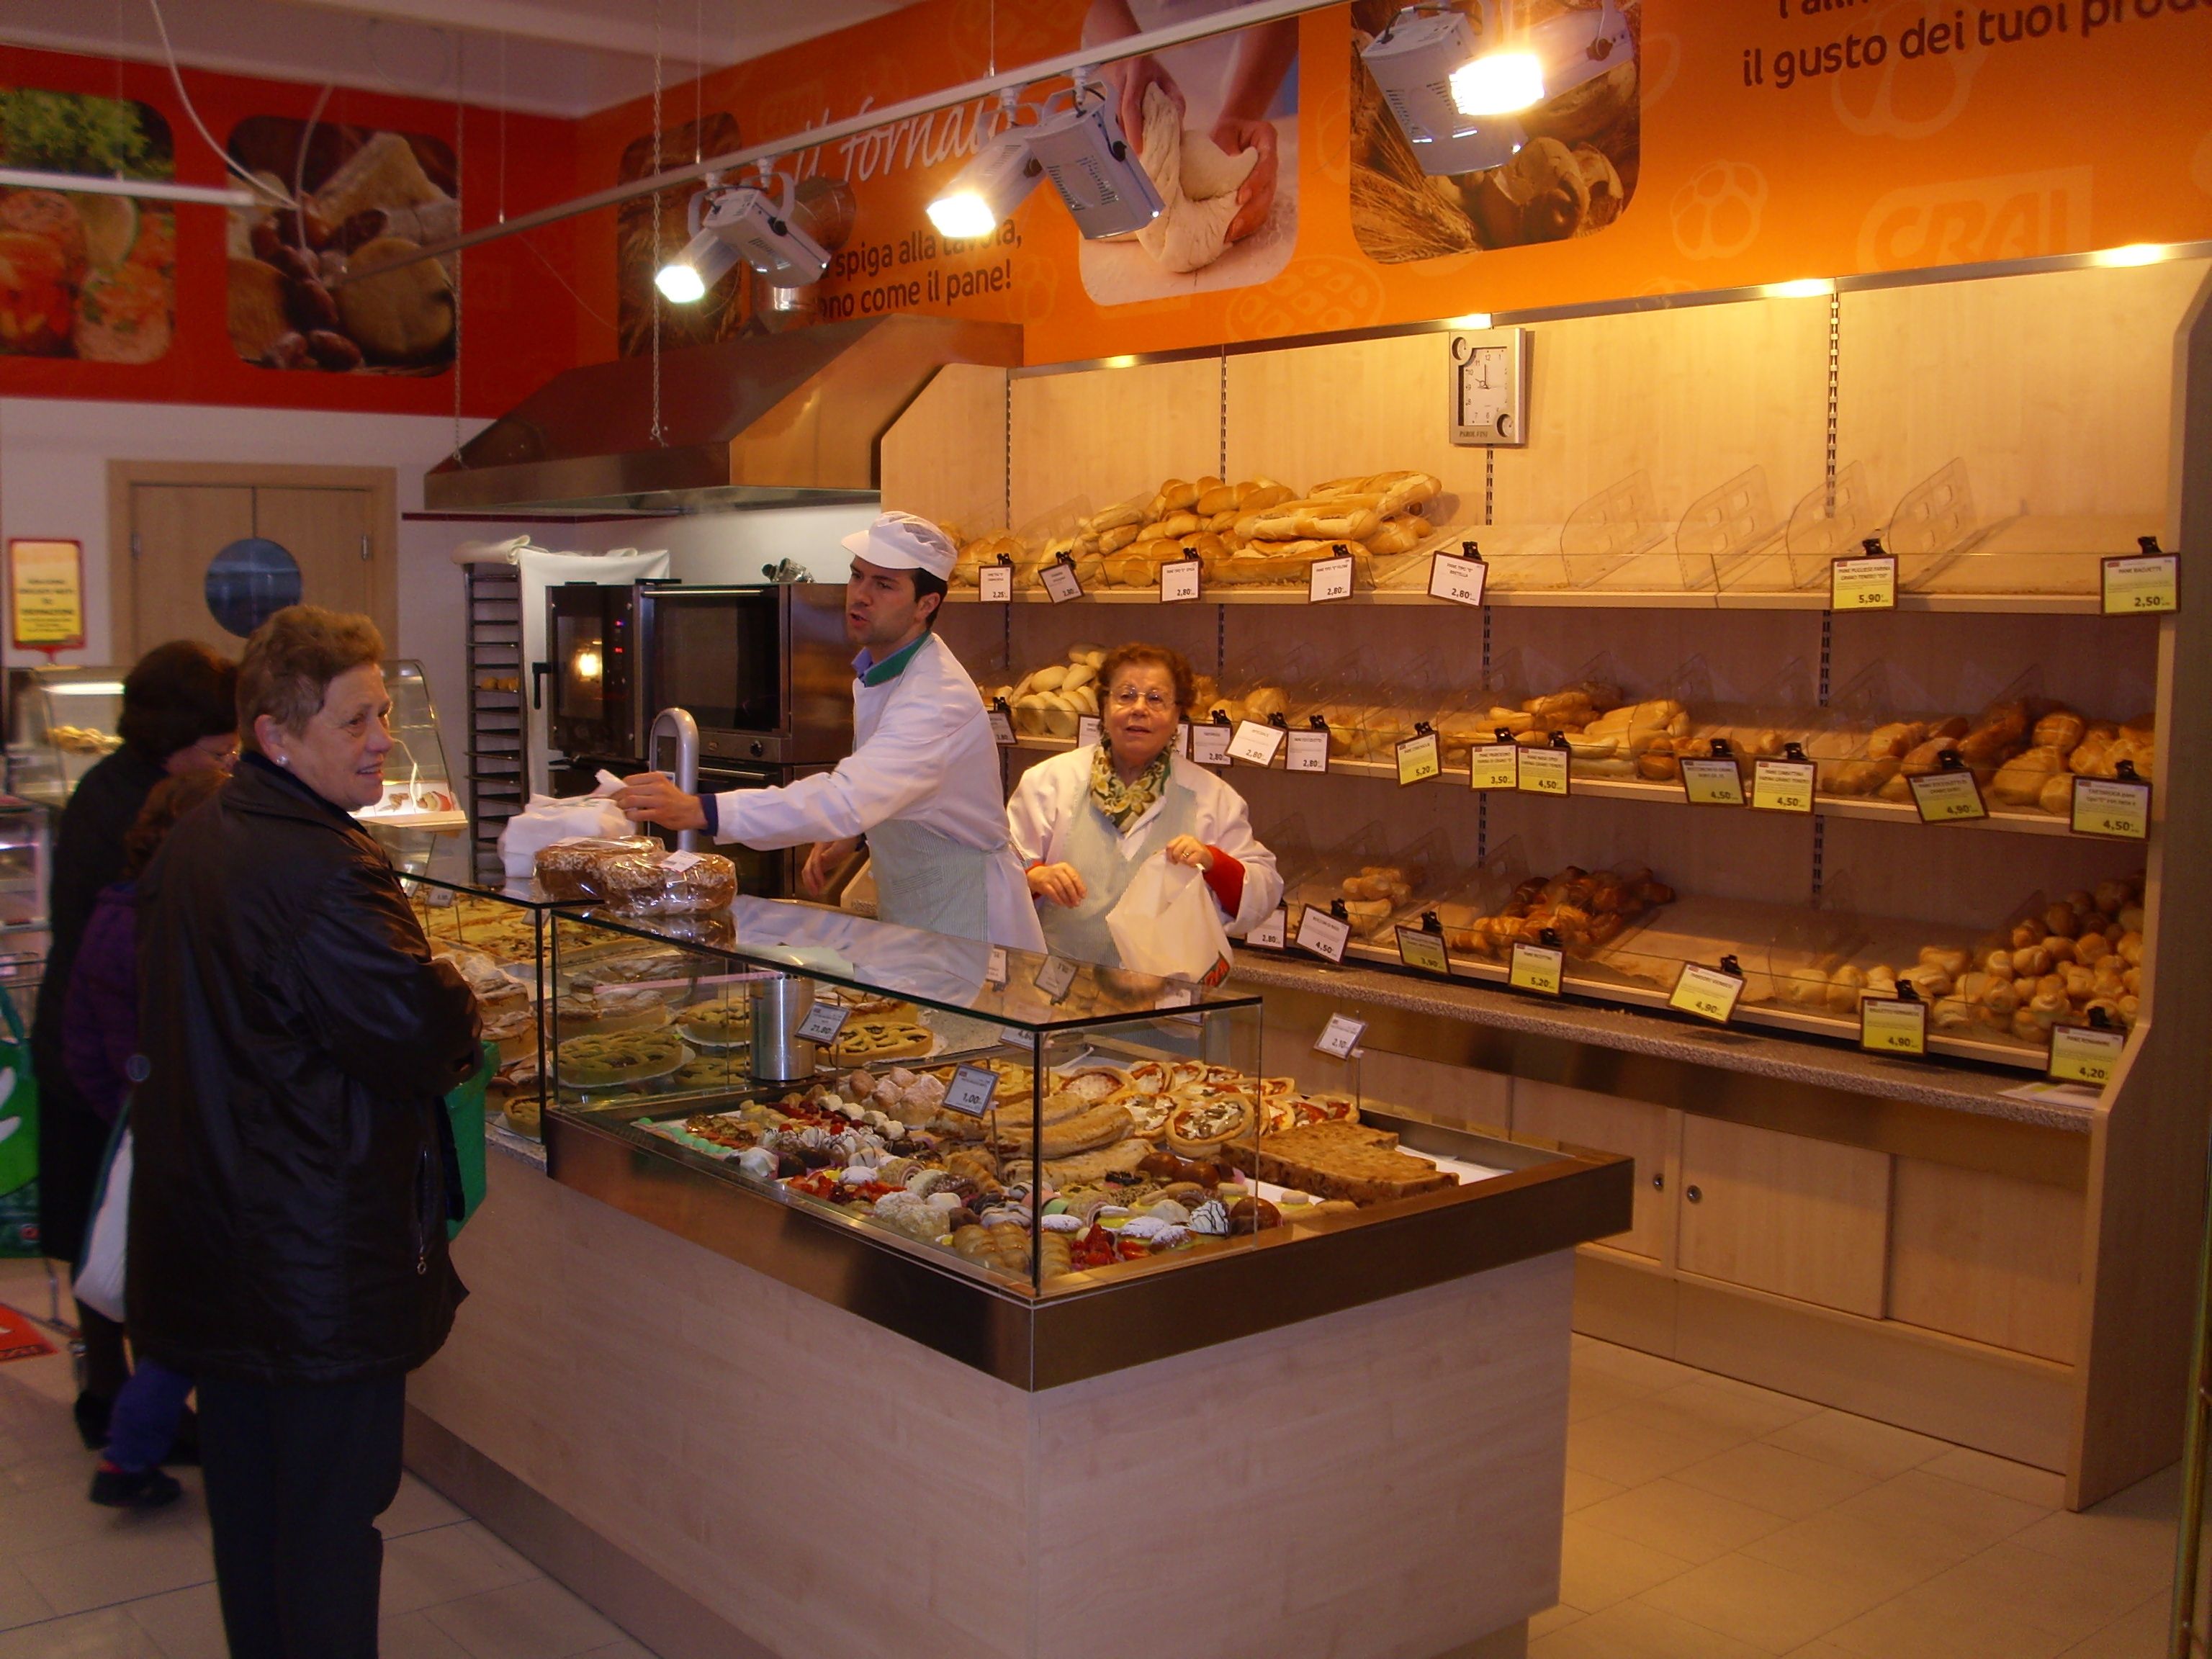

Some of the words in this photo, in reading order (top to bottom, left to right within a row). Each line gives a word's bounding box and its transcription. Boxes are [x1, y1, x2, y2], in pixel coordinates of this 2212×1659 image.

[1743, 48, 1763, 87] il
[1773, 35, 1887, 89] gusto
[1899, 10, 1965, 59] dei
[1978, 2, 2068, 46] tuoi
[1874, 189, 2069, 271] CRAI
[835, 242, 894, 282] spiga
[899, 230, 936, 265] alla
[860, 280, 920, 314] come
[927, 269, 940, 303] il
[946, 258, 1012, 307] pane!
[1451, 588, 1470, 600] 2,80
[1858, 593, 1881, 604] 5,90
[2134, 596, 2160, 608] 2,50
[1538, 779, 1557, 789] 4,50
[1777, 796, 1799, 806] 4,50
[2103, 819, 2130, 832] 4,50
[1530, 976, 1549, 988] 5,20
[1695, 1000, 1717, 1014] 4,90
[2079, 1066, 2105, 1079] 4,20
